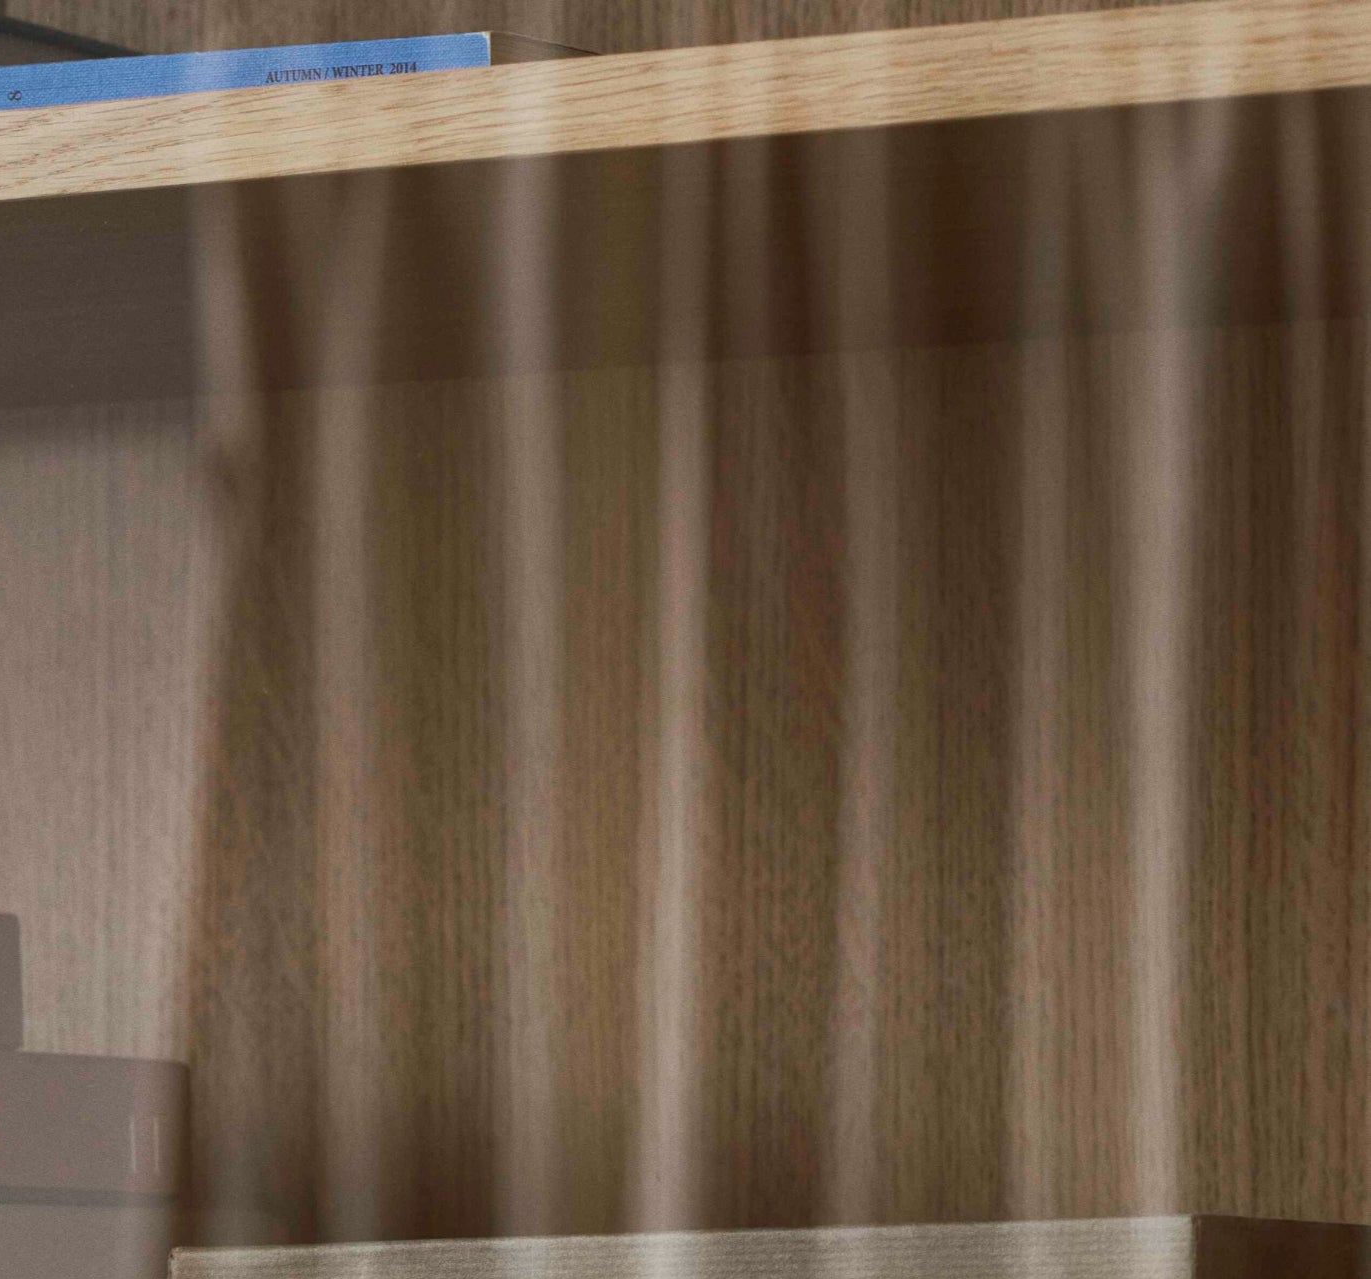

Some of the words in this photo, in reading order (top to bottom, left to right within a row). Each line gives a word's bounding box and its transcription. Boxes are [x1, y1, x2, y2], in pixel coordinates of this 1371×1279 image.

[265, 68, 322, 83] AUTUMN
[331, 63, 384, 79] WINTER
[390, 61, 418, 75] 2014
